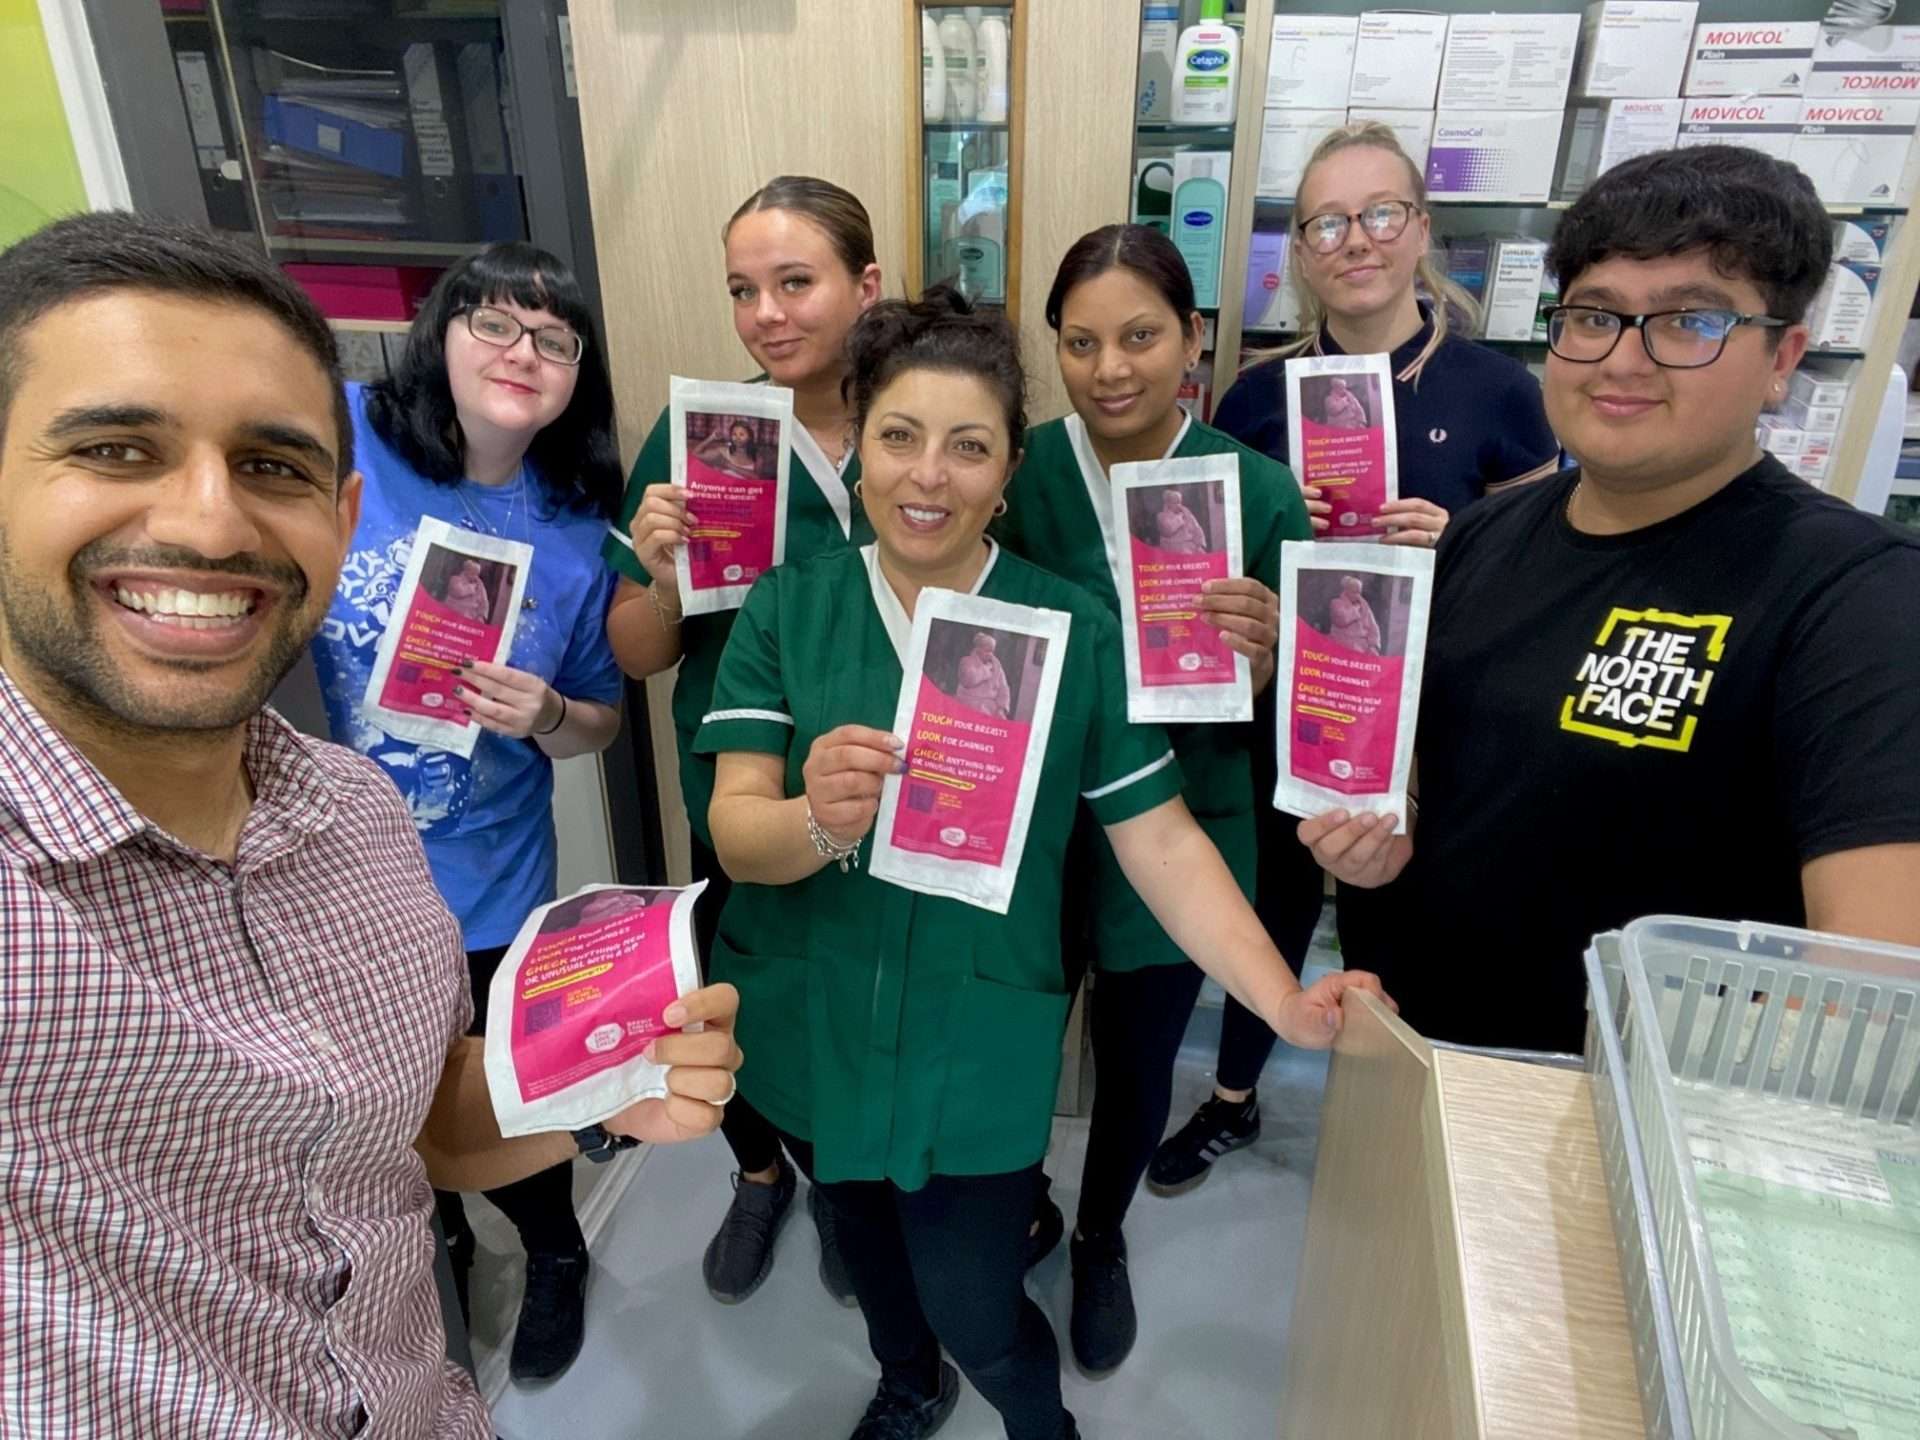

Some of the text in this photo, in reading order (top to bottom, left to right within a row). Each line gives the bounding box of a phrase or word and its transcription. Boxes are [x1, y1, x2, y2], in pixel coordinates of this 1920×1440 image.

[1705, 31, 1783, 45] MOVICOL
[1190, 55, 1225, 66] Cetaphil
[1702, 50, 1726, 59] Plain
[1842, 76, 1920, 89] MOVICOL
[1623, 103, 1664, 112] MOVICOL
[1690, 107, 1766, 120] MOVICOL
[1805, 108, 1884, 121] MOVICOL
[1438, 128, 1483, 137] CosmoCol
[1687, 124, 1710, 132] Plain
[1802, 126, 1826, 134] Plain
[690, 481, 726, 493] Anyone
[747, 487, 763, 495] get
[1620, 626, 1696, 665] THE
[1575, 652, 1714, 706] NORTH
[1577, 682, 1681, 731] FACE
[921, 711, 1008, 738] TOUCH YOUR BREASTS
[916, 729, 995, 754] LOOK FOR CHANGES
[913, 748, 945, 763] CHECK
[946, 756, 985, 770] ANYTHING
[537, 935, 576, 954] TOUCH
[526, 932, 646, 976] CHECK ANYTHING NEW
[524, 942, 639, 986] OR UNUSUAL WITH A GP
